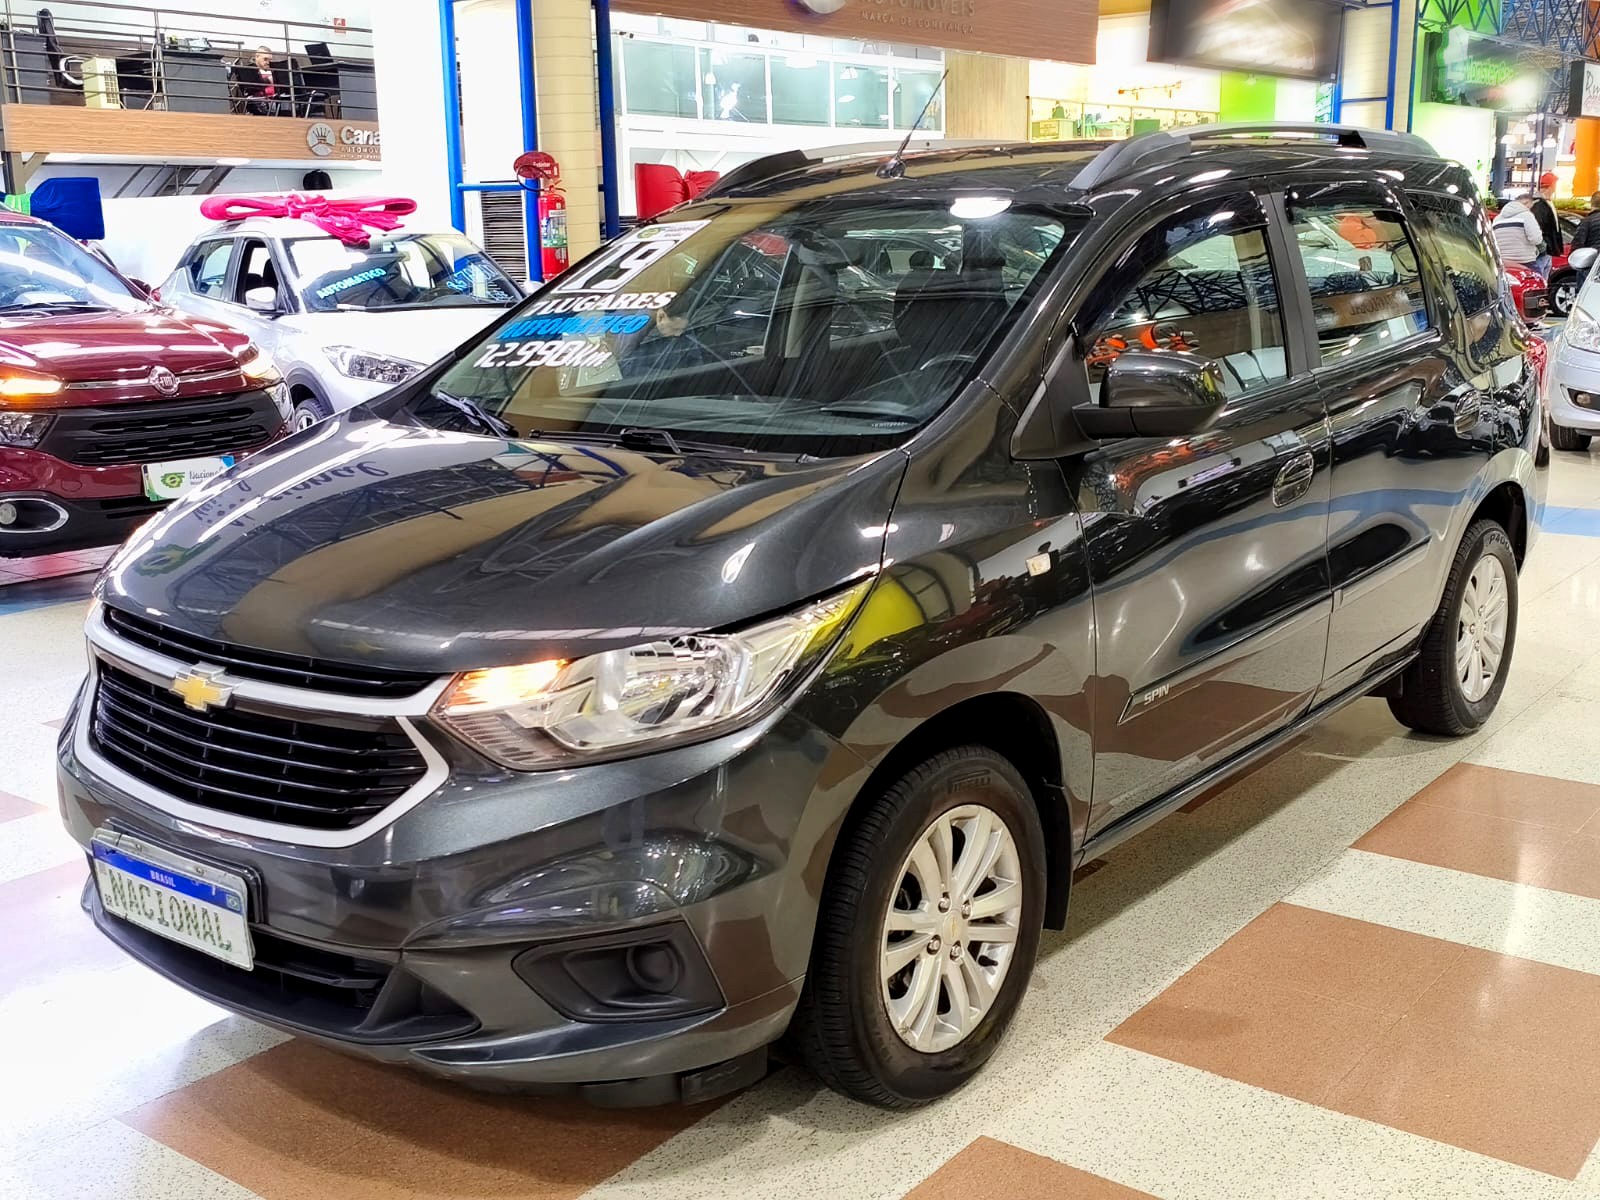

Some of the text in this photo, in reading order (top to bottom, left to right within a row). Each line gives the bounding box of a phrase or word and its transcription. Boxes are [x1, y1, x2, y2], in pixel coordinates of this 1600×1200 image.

[861, 10, 974, 35] MARCA DE CONFIANÇA
[1143, 683, 1170, 706] SPIN
[150, 869, 176, 888] BRASIL
[108, 868, 233, 952] NACIONAL
